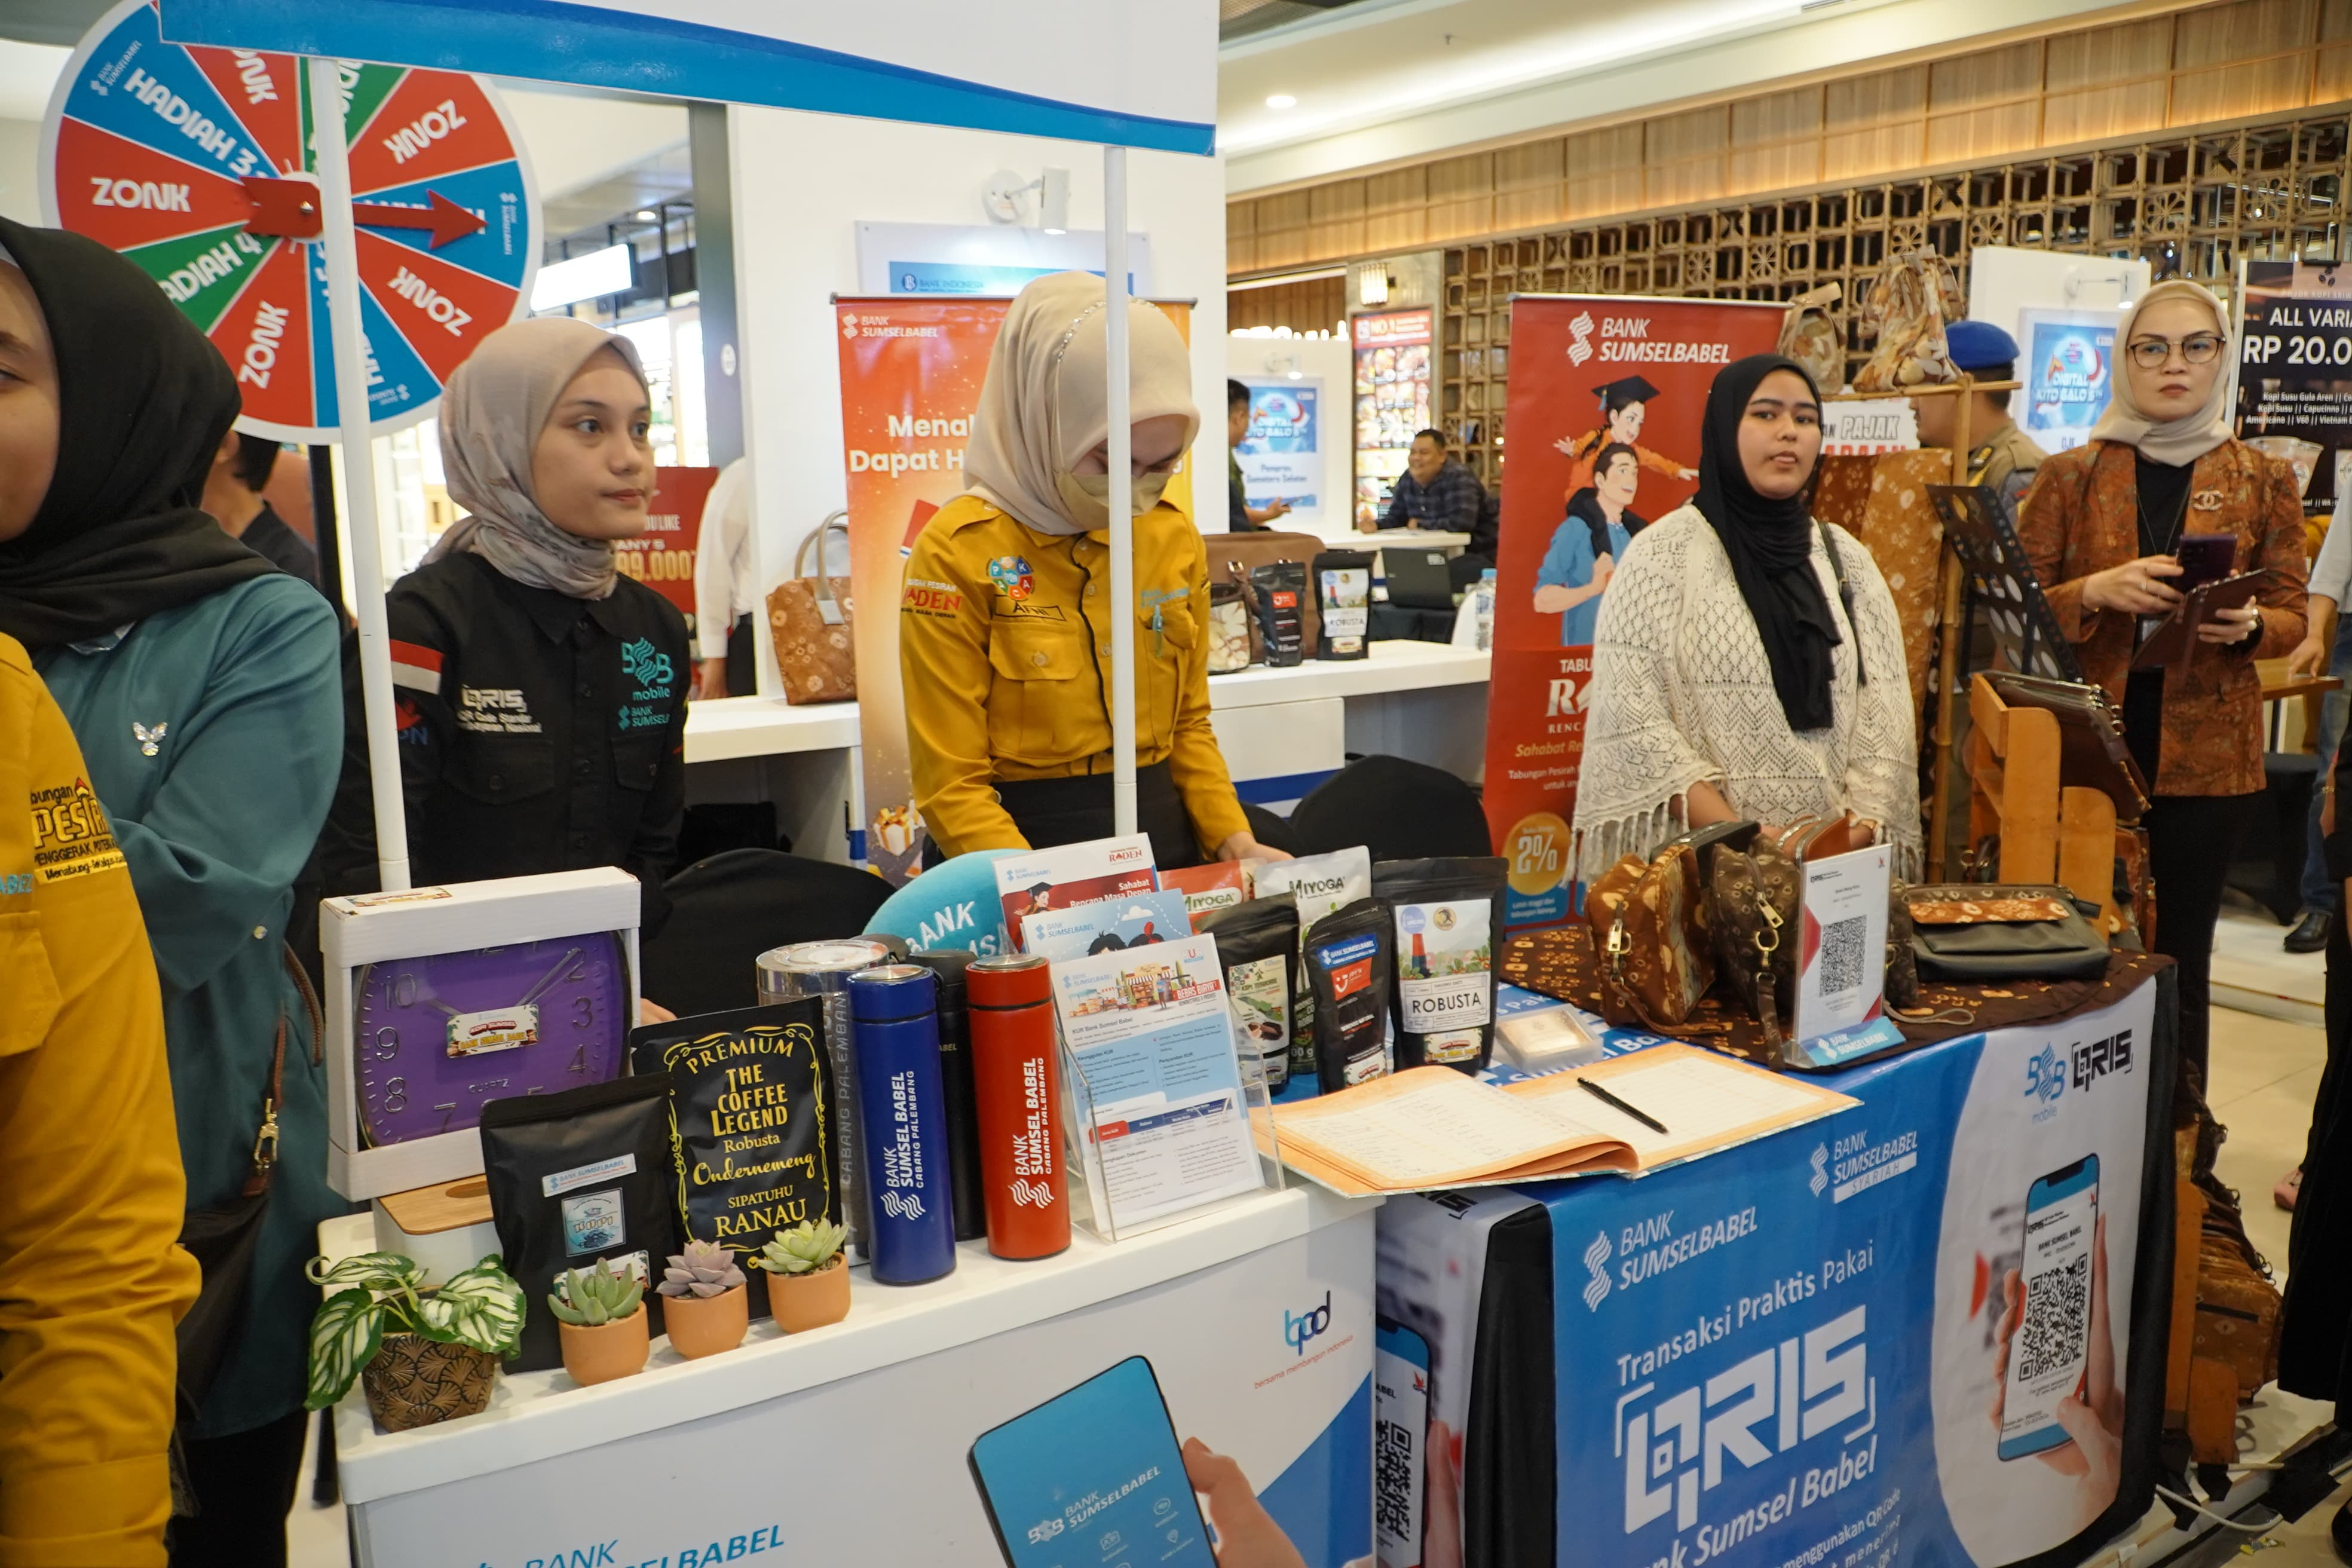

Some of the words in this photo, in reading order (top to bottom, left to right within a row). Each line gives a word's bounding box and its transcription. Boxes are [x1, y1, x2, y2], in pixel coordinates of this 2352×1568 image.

[124, 67, 237, 161] HADIAH
[228, 148, 258, 176] 3
[383, 100, 467, 164] ZONK
[91, 176, 191, 213] ZONK
[160, 243, 240, 303] ADIAH
[238, 233, 263, 255] 4
[387, 265, 472, 337] ZONK
[2270, 307, 2304, 326] ALL
[862, 315, 890, 326] BANK
[862, 327, 939, 338] SUMSELBABEL
[1601, 318, 1650, 338] BANK
[241, 301, 289, 390] ZONK
[1599, 342, 1730, 363] SUMSELBABEL
[2243, 335, 2281, 364] RP
[2287, 335, 2352, 365] 20.0
[2052, 373, 2089, 387] DIGITAL
[2258, 403, 2274, 413] Kopi
[2276, 404, 2293, 412] Susu
[2263, 392, 2279, 402] Kopi
[2280, 392, 2298, 401] Susu
[2300, 393, 2316, 402] Gula
[2317, 392, 2333, 402] Aren
[1841, 416, 1900, 440] PAJAK
[2320, 415, 2348, 424] Vietnam
[849, 450, 940, 478] Dapat
[659, 514, 681, 531] LIKE
[615, 540, 651, 551] ANY
[903, 588, 962, 611] ADEN
[462, 684, 527, 712] QRIS
[632, 686, 670, 700] mobile
[1549, 722, 1587, 734] RENC
[1515, 742, 1565, 757] Sahabat
[1508, 768, 1546, 780] Tabungan
[1109, 850, 1143, 862] RADEN
[1517, 834, 1558, 874] 2%
[1104, 892, 1125, 902] Masa
[1119, 879, 1150, 891] Sahabat
[1289, 878, 1344, 898] MIYOGA
[1048, 924, 1095, 938] SUMSELBABEL
[381, 973, 416, 1011] 10
[1412, 992, 1481, 1014] ROBUSTA
[1505, 996, 1552, 1010] Pak
[572, 997, 592, 1028] 3
[1072, 1025, 1085, 1034] KUR
[1085, 1022, 1098, 1032] Bank
[1099, 1019, 1117, 1029] Sumsel
[376, 1027, 399, 1060] 9
[835, 995, 849, 1101] PALEMBAN
[1830, 1033, 1851, 1046] BANK
[1837, 1032, 1888, 1055] SUMSELBABEL
[567, 1045, 587, 1076] 4
[686, 1037, 794, 1074] PREMIUM
[2071, 1028, 2133, 1092] QRIS
[726, 1064, 764, 1092] THE
[1023, 1057, 1038, 1108] BABEL
[1039, 1057, 1049, 1127] PALEMBANG
[384, 1077, 406, 1113] 8
[718, 1084, 788, 1113] COFFEE
[892, 1072, 908, 1123] BABEL
[906, 1070, 921, 1139] PALEMBANG
[434, 1102, 457, 1134] 7
[711, 1105, 788, 1137] LEGEND
[2032, 1105, 2057, 1125] mobile
[723, 1134, 781, 1154] Robusta
[840, 1108, 852, 1184] CABANG
[896, 1126, 913, 1187] SUMSEL
[1012, 1135, 1031, 1176] BANK
[1026, 1113, 1045, 1175] SUMSEL
[1043, 1131, 1052, 1175] CABANG
[1833, 1129, 1867, 1159] BANK
[1833, 1131, 1918, 1184] SUMSELBABEL
[559, 1172, 577, 1181] BANK
[578, 1160, 624, 1176] SUMSELBABEL
[883, 1147, 898, 1187] BANK
[912, 1141, 924, 1188] CABANG
[1852, 1161, 1900, 1194] SYARIAH
[727, 1185, 794, 1209] SIPATUHU
[714, 1199, 807, 1238] RANAU
[1619, 1209, 1674, 1256] BANK
[1619, 1206, 1758, 1291] SUMSELBABEL
[1617, 1306, 1731, 1387] Transaksi
[1738, 1270, 1816, 1328] Praktis
[1823, 1240, 1873, 1290] Pakai
[1254, 1369, 1285, 1390] bersama
[1286, 1351, 1325, 1376] membangun
[1327, 1334, 1354, 1355] indonesia
[1616, 1304, 1875, 1534] QRIS
[1065, 1491, 1100, 1518] BANK
[1068, 1465, 1162, 1529] SUMSELBABEL
[1693, 1477, 1796, 1566] Sumsel
[1802, 1434, 1878, 1508] Babel
[1783, 1520, 1865, 1568] menggunakan
[1866, 1505, 1882, 1526] QR
